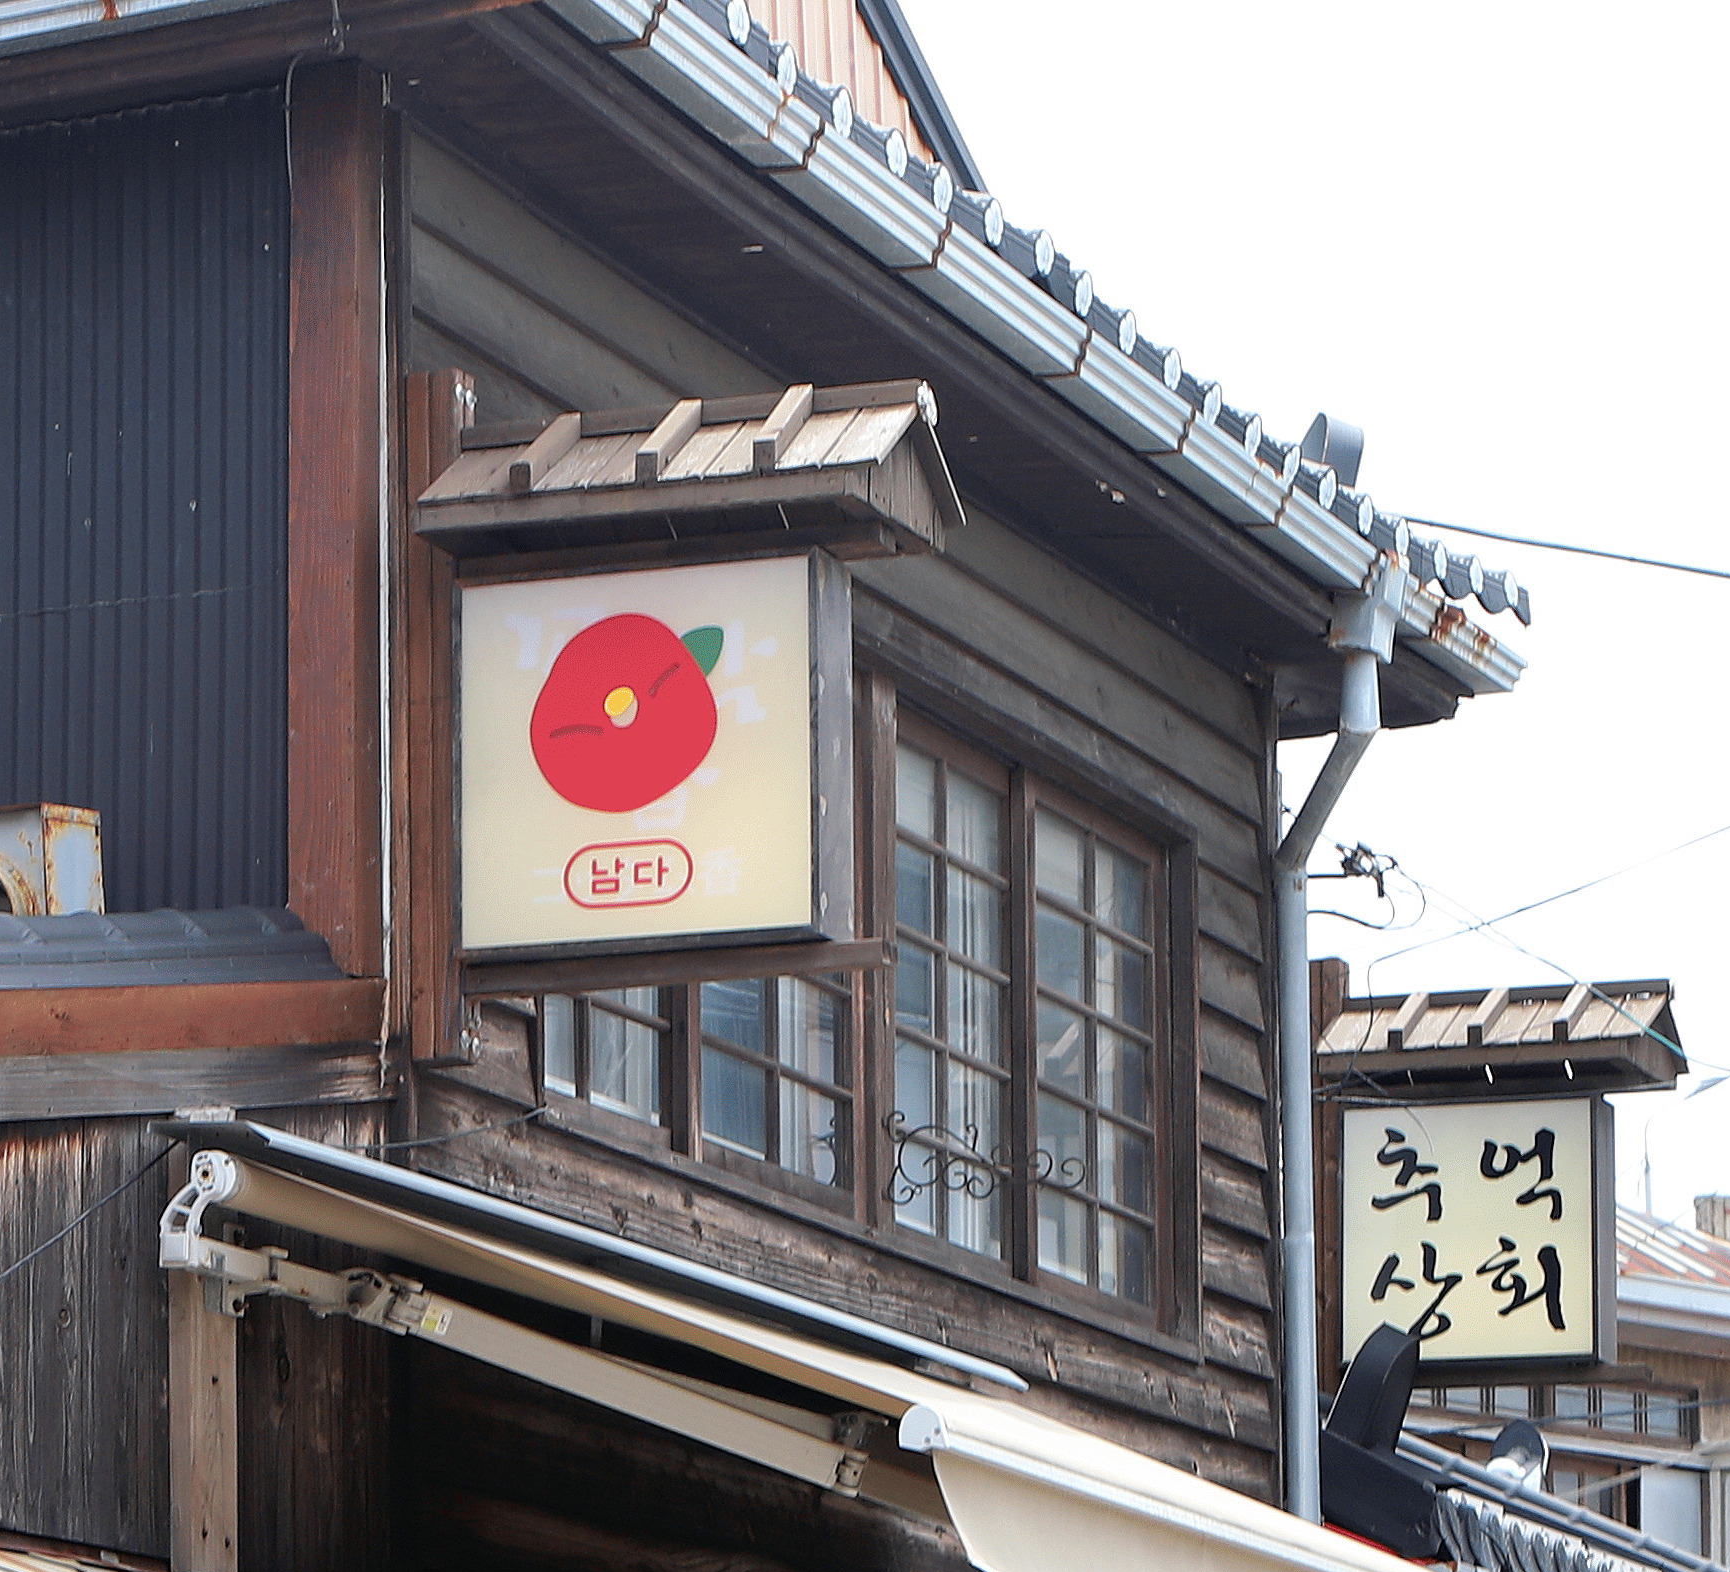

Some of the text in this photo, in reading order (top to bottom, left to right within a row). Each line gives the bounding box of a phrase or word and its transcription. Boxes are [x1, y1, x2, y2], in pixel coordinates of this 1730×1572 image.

[591, 855, 669, 895] 남다
[1371, 1127, 1563, 1222] 추억
[1370, 1236, 1566, 1341] 상회
